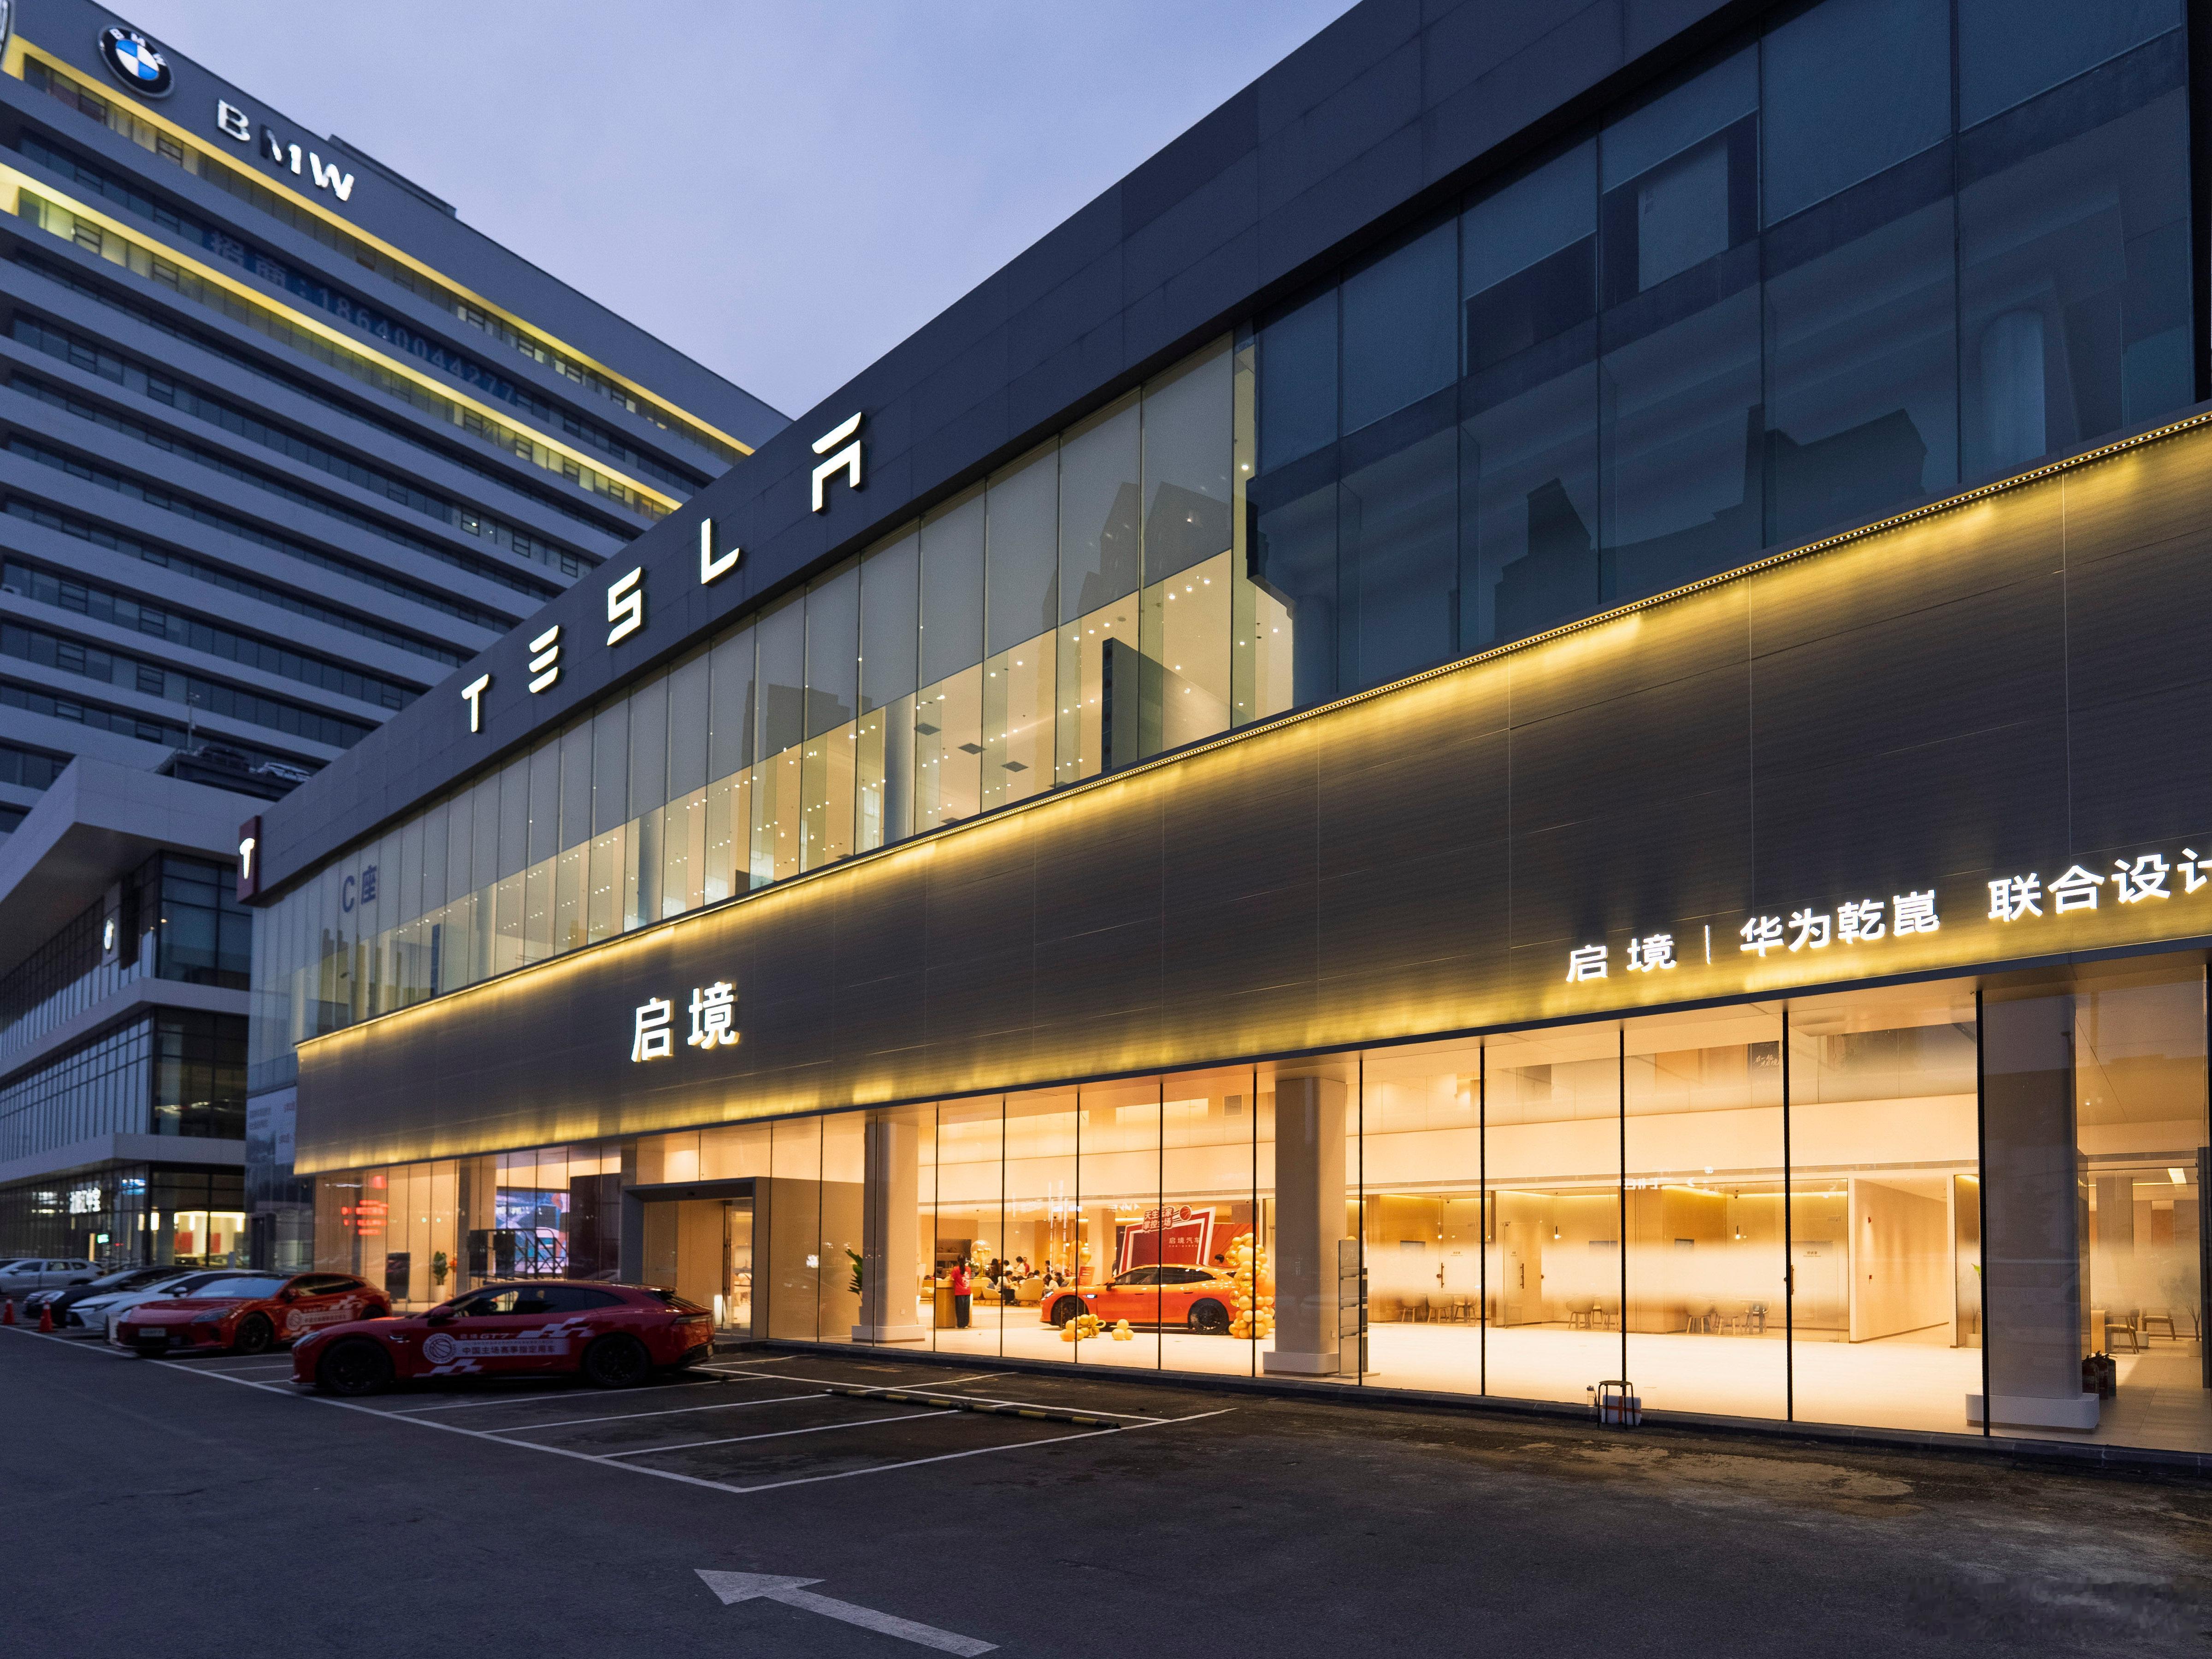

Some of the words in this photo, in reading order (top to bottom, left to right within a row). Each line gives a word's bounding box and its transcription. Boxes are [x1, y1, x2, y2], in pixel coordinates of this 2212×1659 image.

[218, 99, 354, 201] BMW
[461, 412, 862, 732] TESLA
[1566, 933, 1677, 982] 启境
[1740, 889, 1940, 957] 华为乾崑
[631, 981, 739, 1062] 启境
